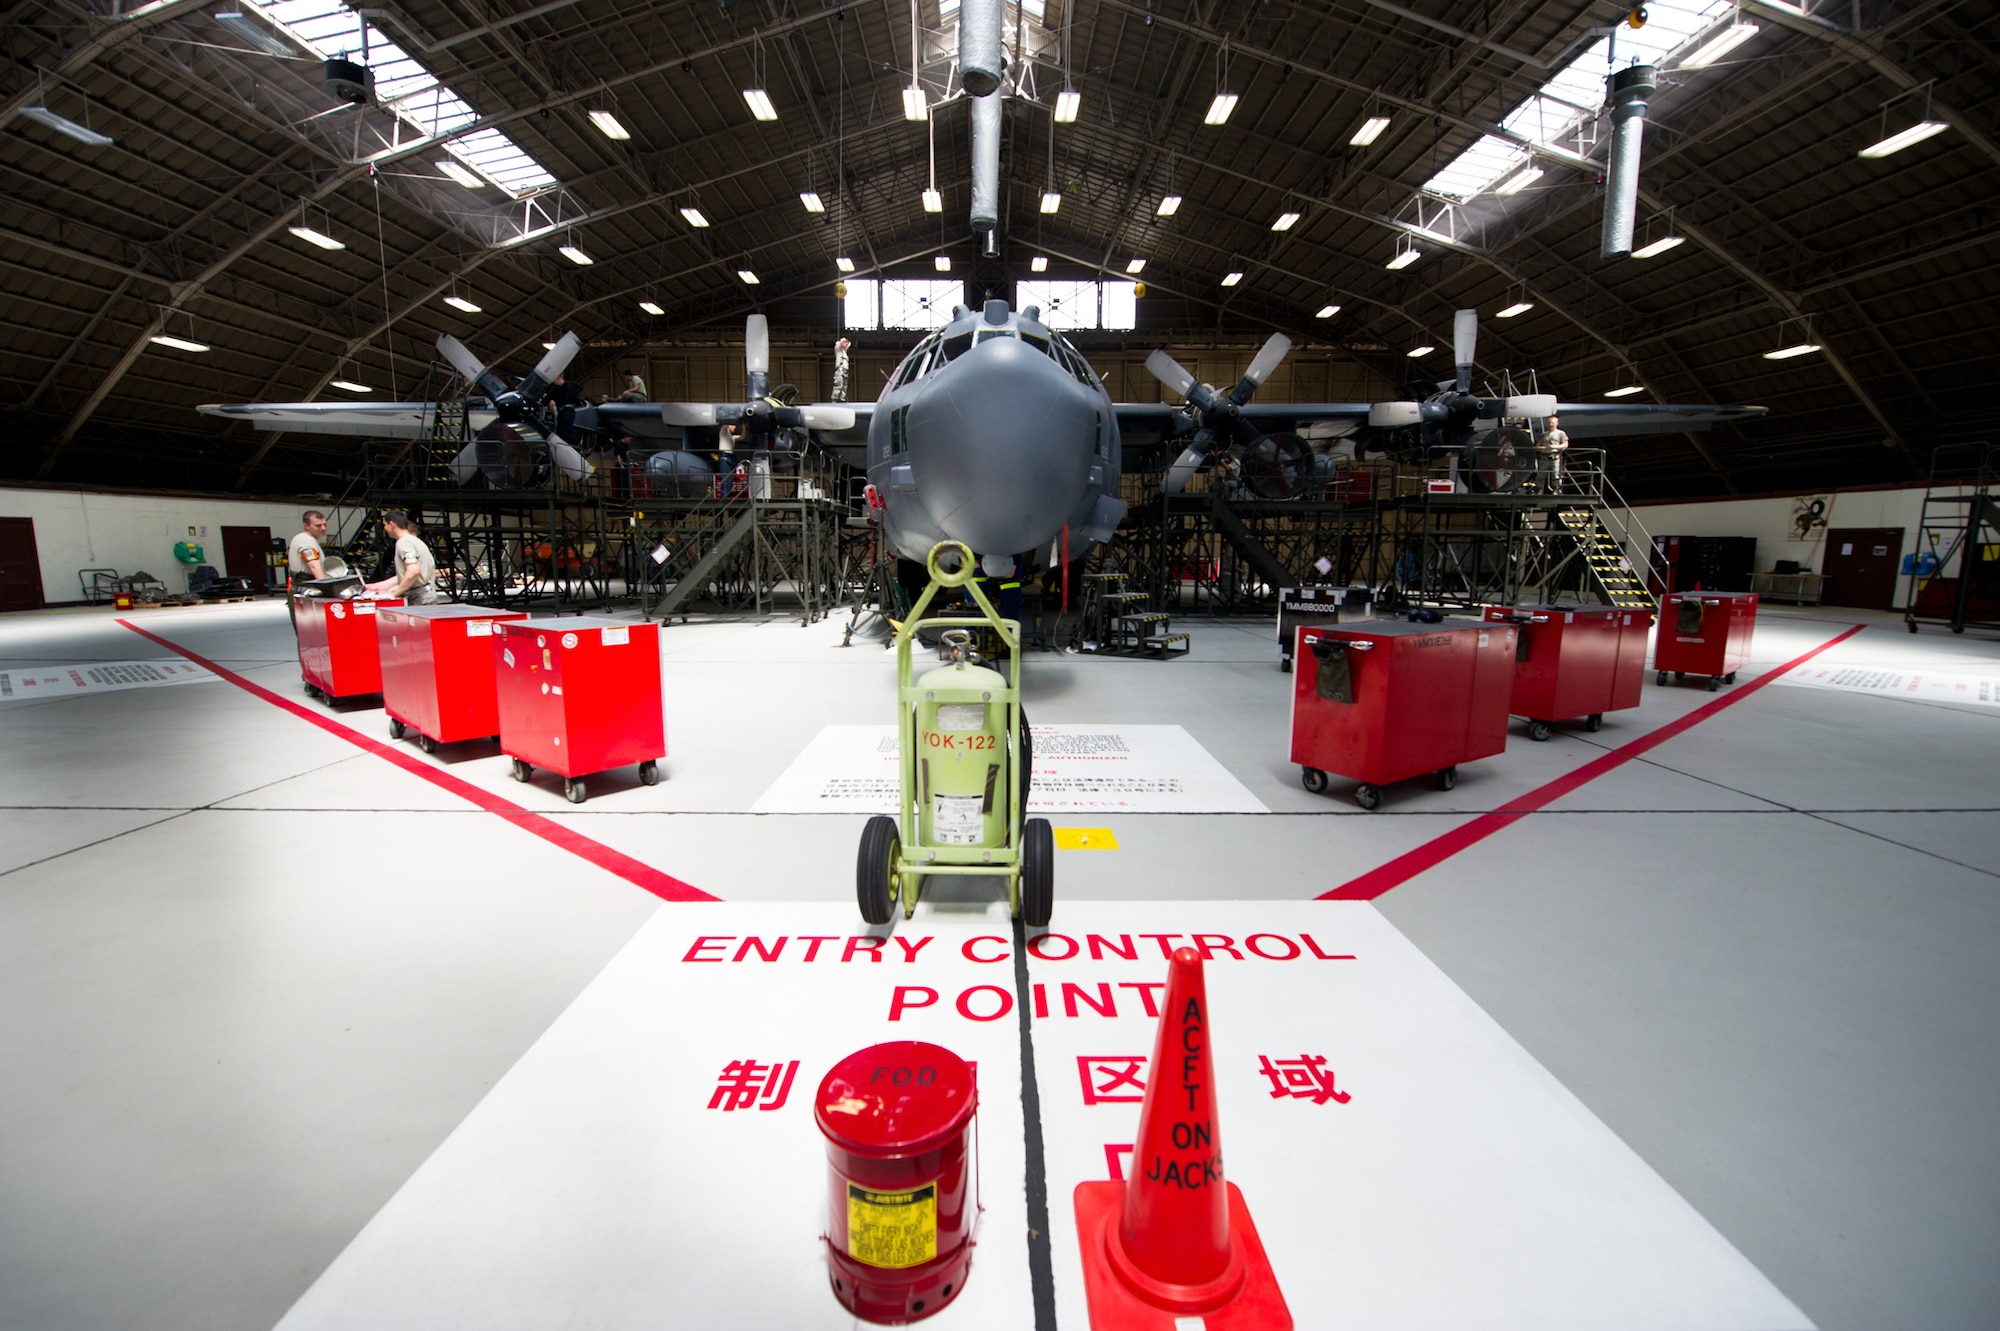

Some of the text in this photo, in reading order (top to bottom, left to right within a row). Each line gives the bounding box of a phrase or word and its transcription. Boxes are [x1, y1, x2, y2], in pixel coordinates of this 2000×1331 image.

[921, 730, 996, 750] YOK-122
[681, 933, 1358, 964] ENTRY CONTROL
[888, 983, 1166, 1022] POINT
[1183, 997, 1203, 1112] ACFT
[870, 1066, 938, 1087] FOD
[1172, 1118, 1211, 1150] ON
